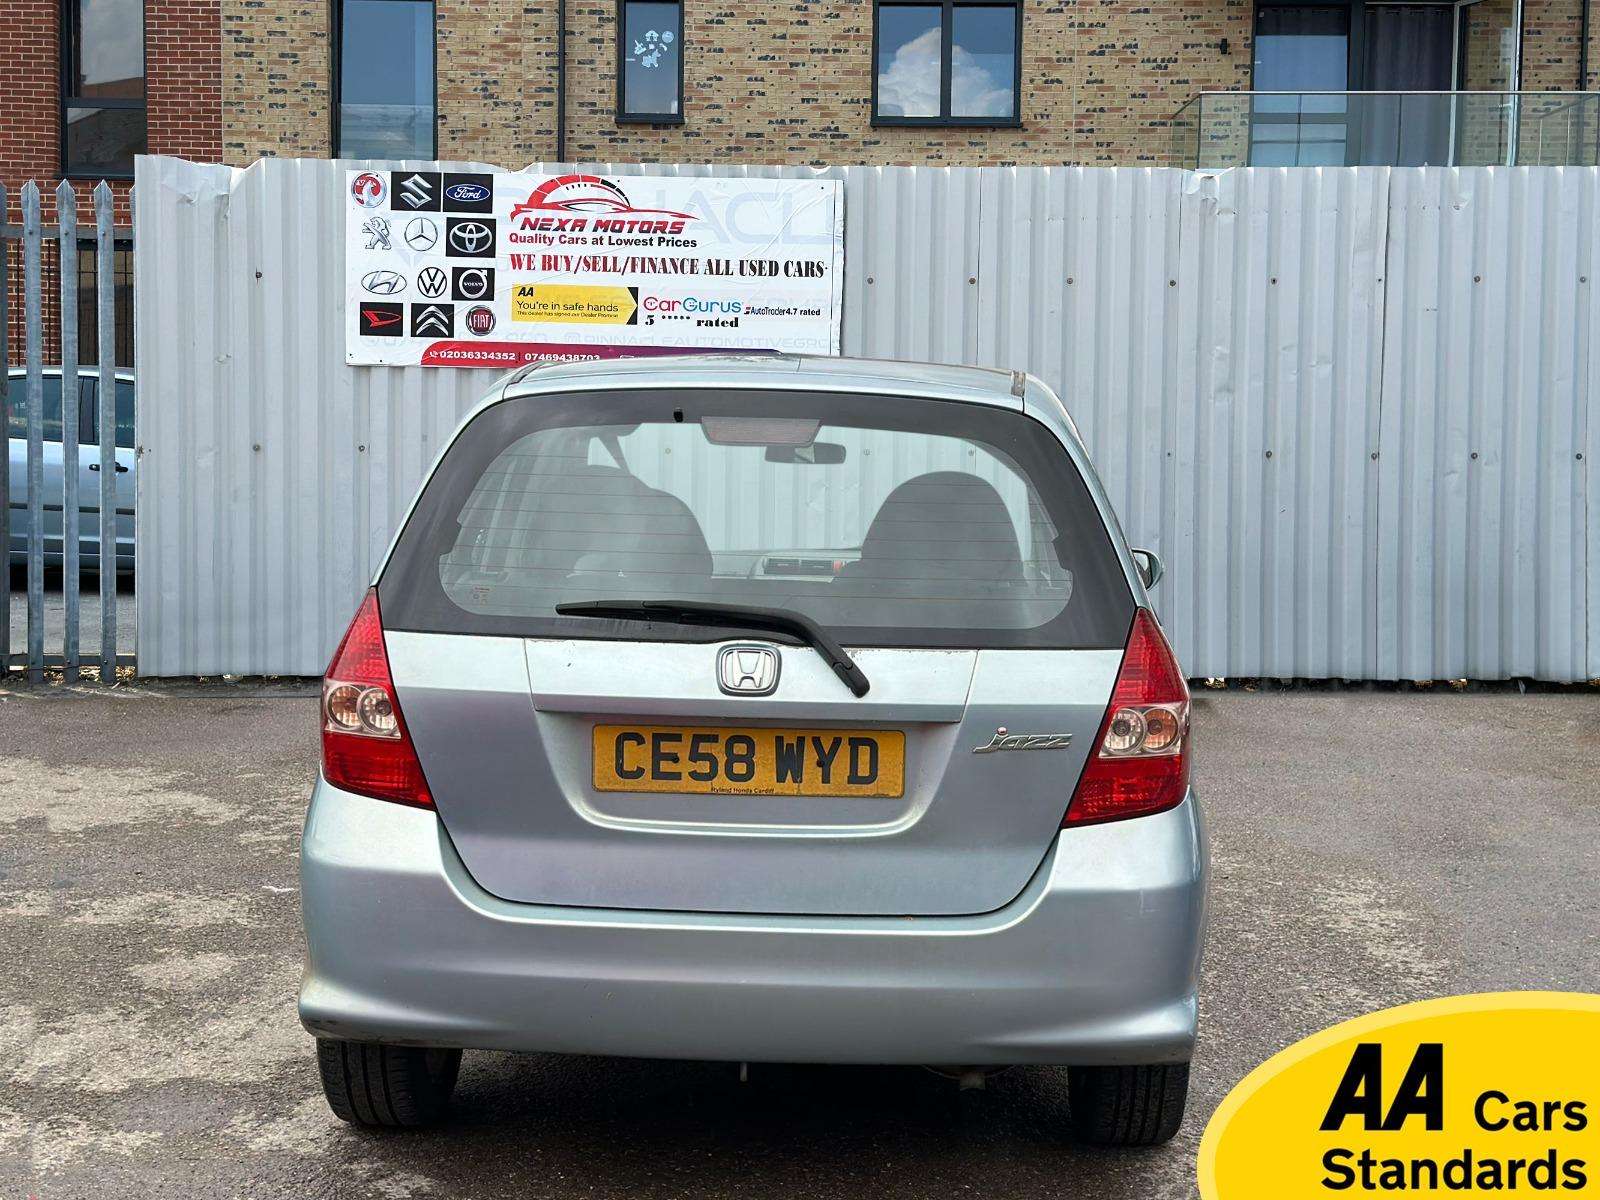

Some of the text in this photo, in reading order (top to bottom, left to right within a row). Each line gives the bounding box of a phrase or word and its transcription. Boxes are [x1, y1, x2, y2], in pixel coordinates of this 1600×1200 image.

[454, 187, 482, 199] Ford
[520, 217, 685, 234] NEXA MOTORS
[509, 232, 697, 248] Quality Cars at Lowest Prices
[510, 253, 536, 271] WE
[704, 258, 733, 276] ALL
[739, 259, 779, 277] USED
[784, 260, 825, 278] CARS
[518, 286, 534, 297] AA
[516, 300, 619, 312] You're in safe hands
[643, 296, 742, 313] CarGurus
[799, 308, 821, 316] rated
[473, 313, 490, 328] FIAT
[644, 314, 739, 328] 5 rated
[440, 350, 516, 361] 02036334352
[615, 731, 879, 785] CE58 WYD
